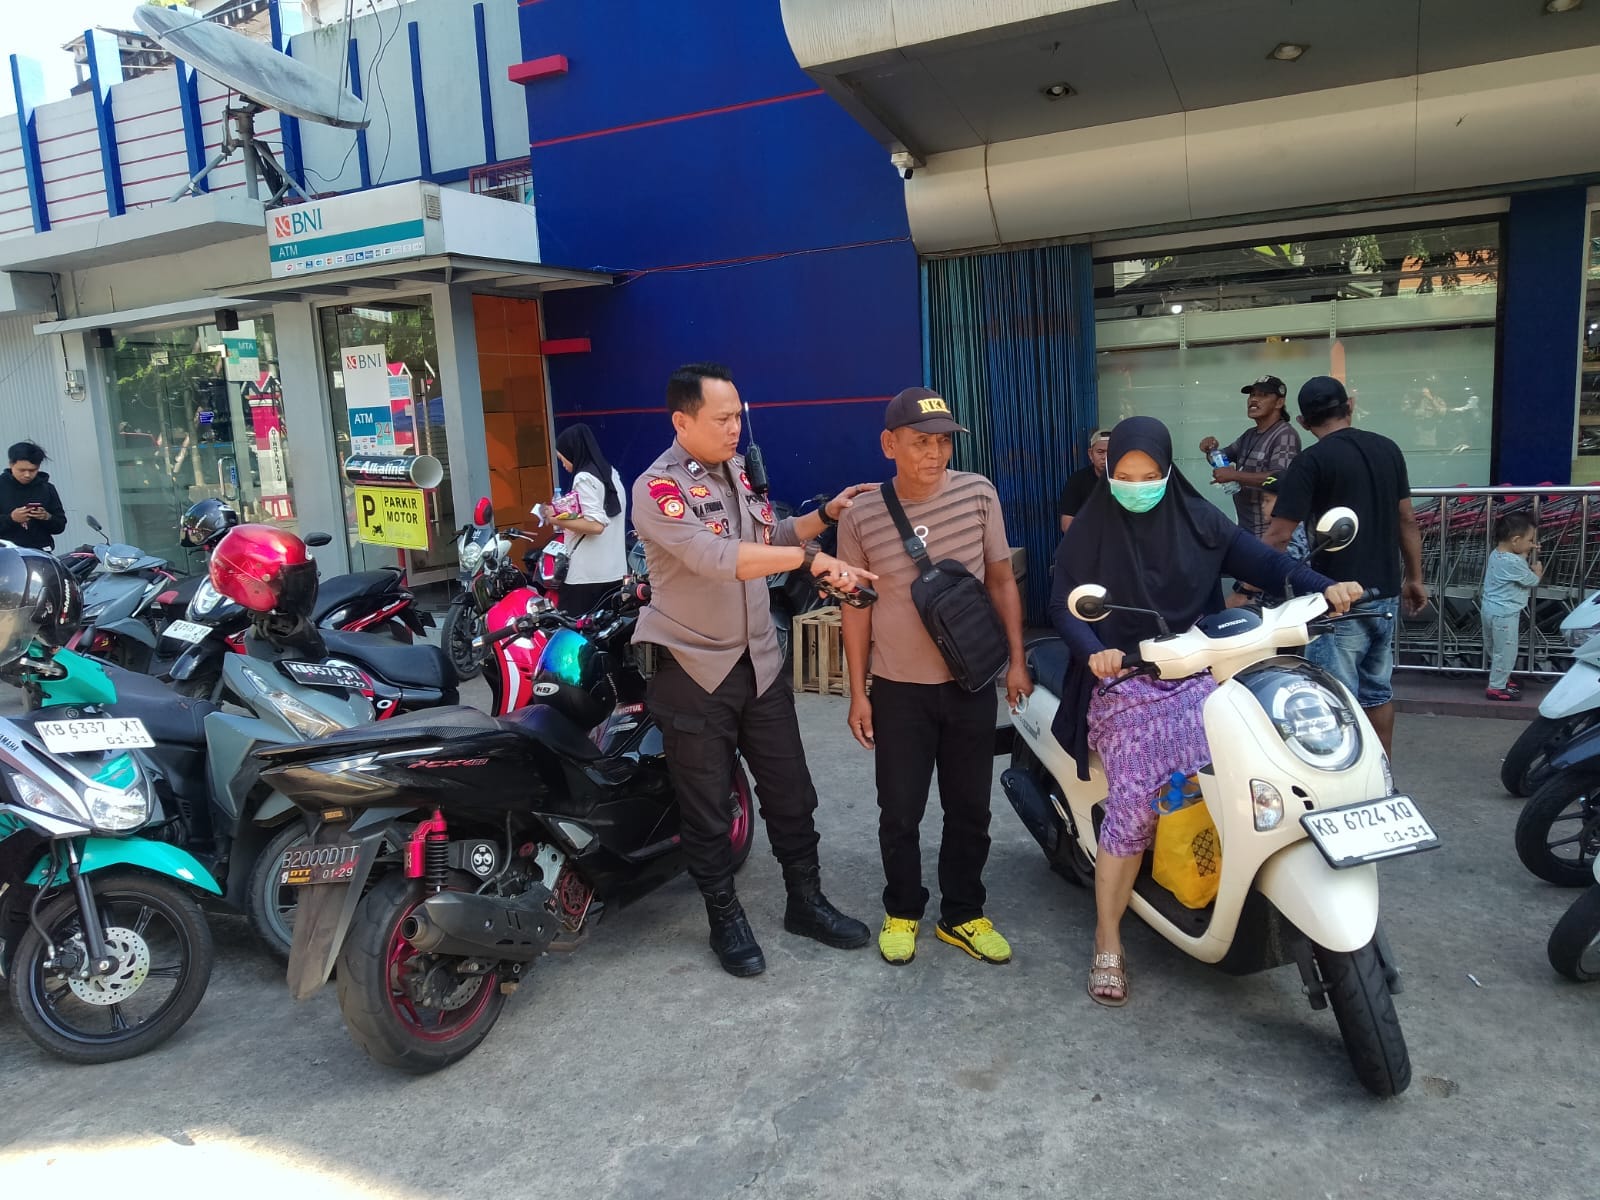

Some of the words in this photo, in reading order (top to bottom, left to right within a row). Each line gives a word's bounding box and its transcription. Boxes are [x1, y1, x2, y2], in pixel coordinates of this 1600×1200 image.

[292, 208, 322, 235] BNI
[279, 245, 298, 258] ATM
[359, 353, 382, 369] BNI
[354, 413, 374, 424] ATM
[375, 422, 391, 438] 24
[360, 461, 405, 475] Alkaline
[384, 496, 418, 510] PARKIR
[362, 495, 376, 528] P
[386, 511, 418, 524] MOTOR
[41, 724, 65, 736] KB
[69, 722, 105, 735] 6337
[120, 721, 141, 732] XT
[1311, 817, 1339, 836] KB
[1343, 807, 1387, 831] 6724
